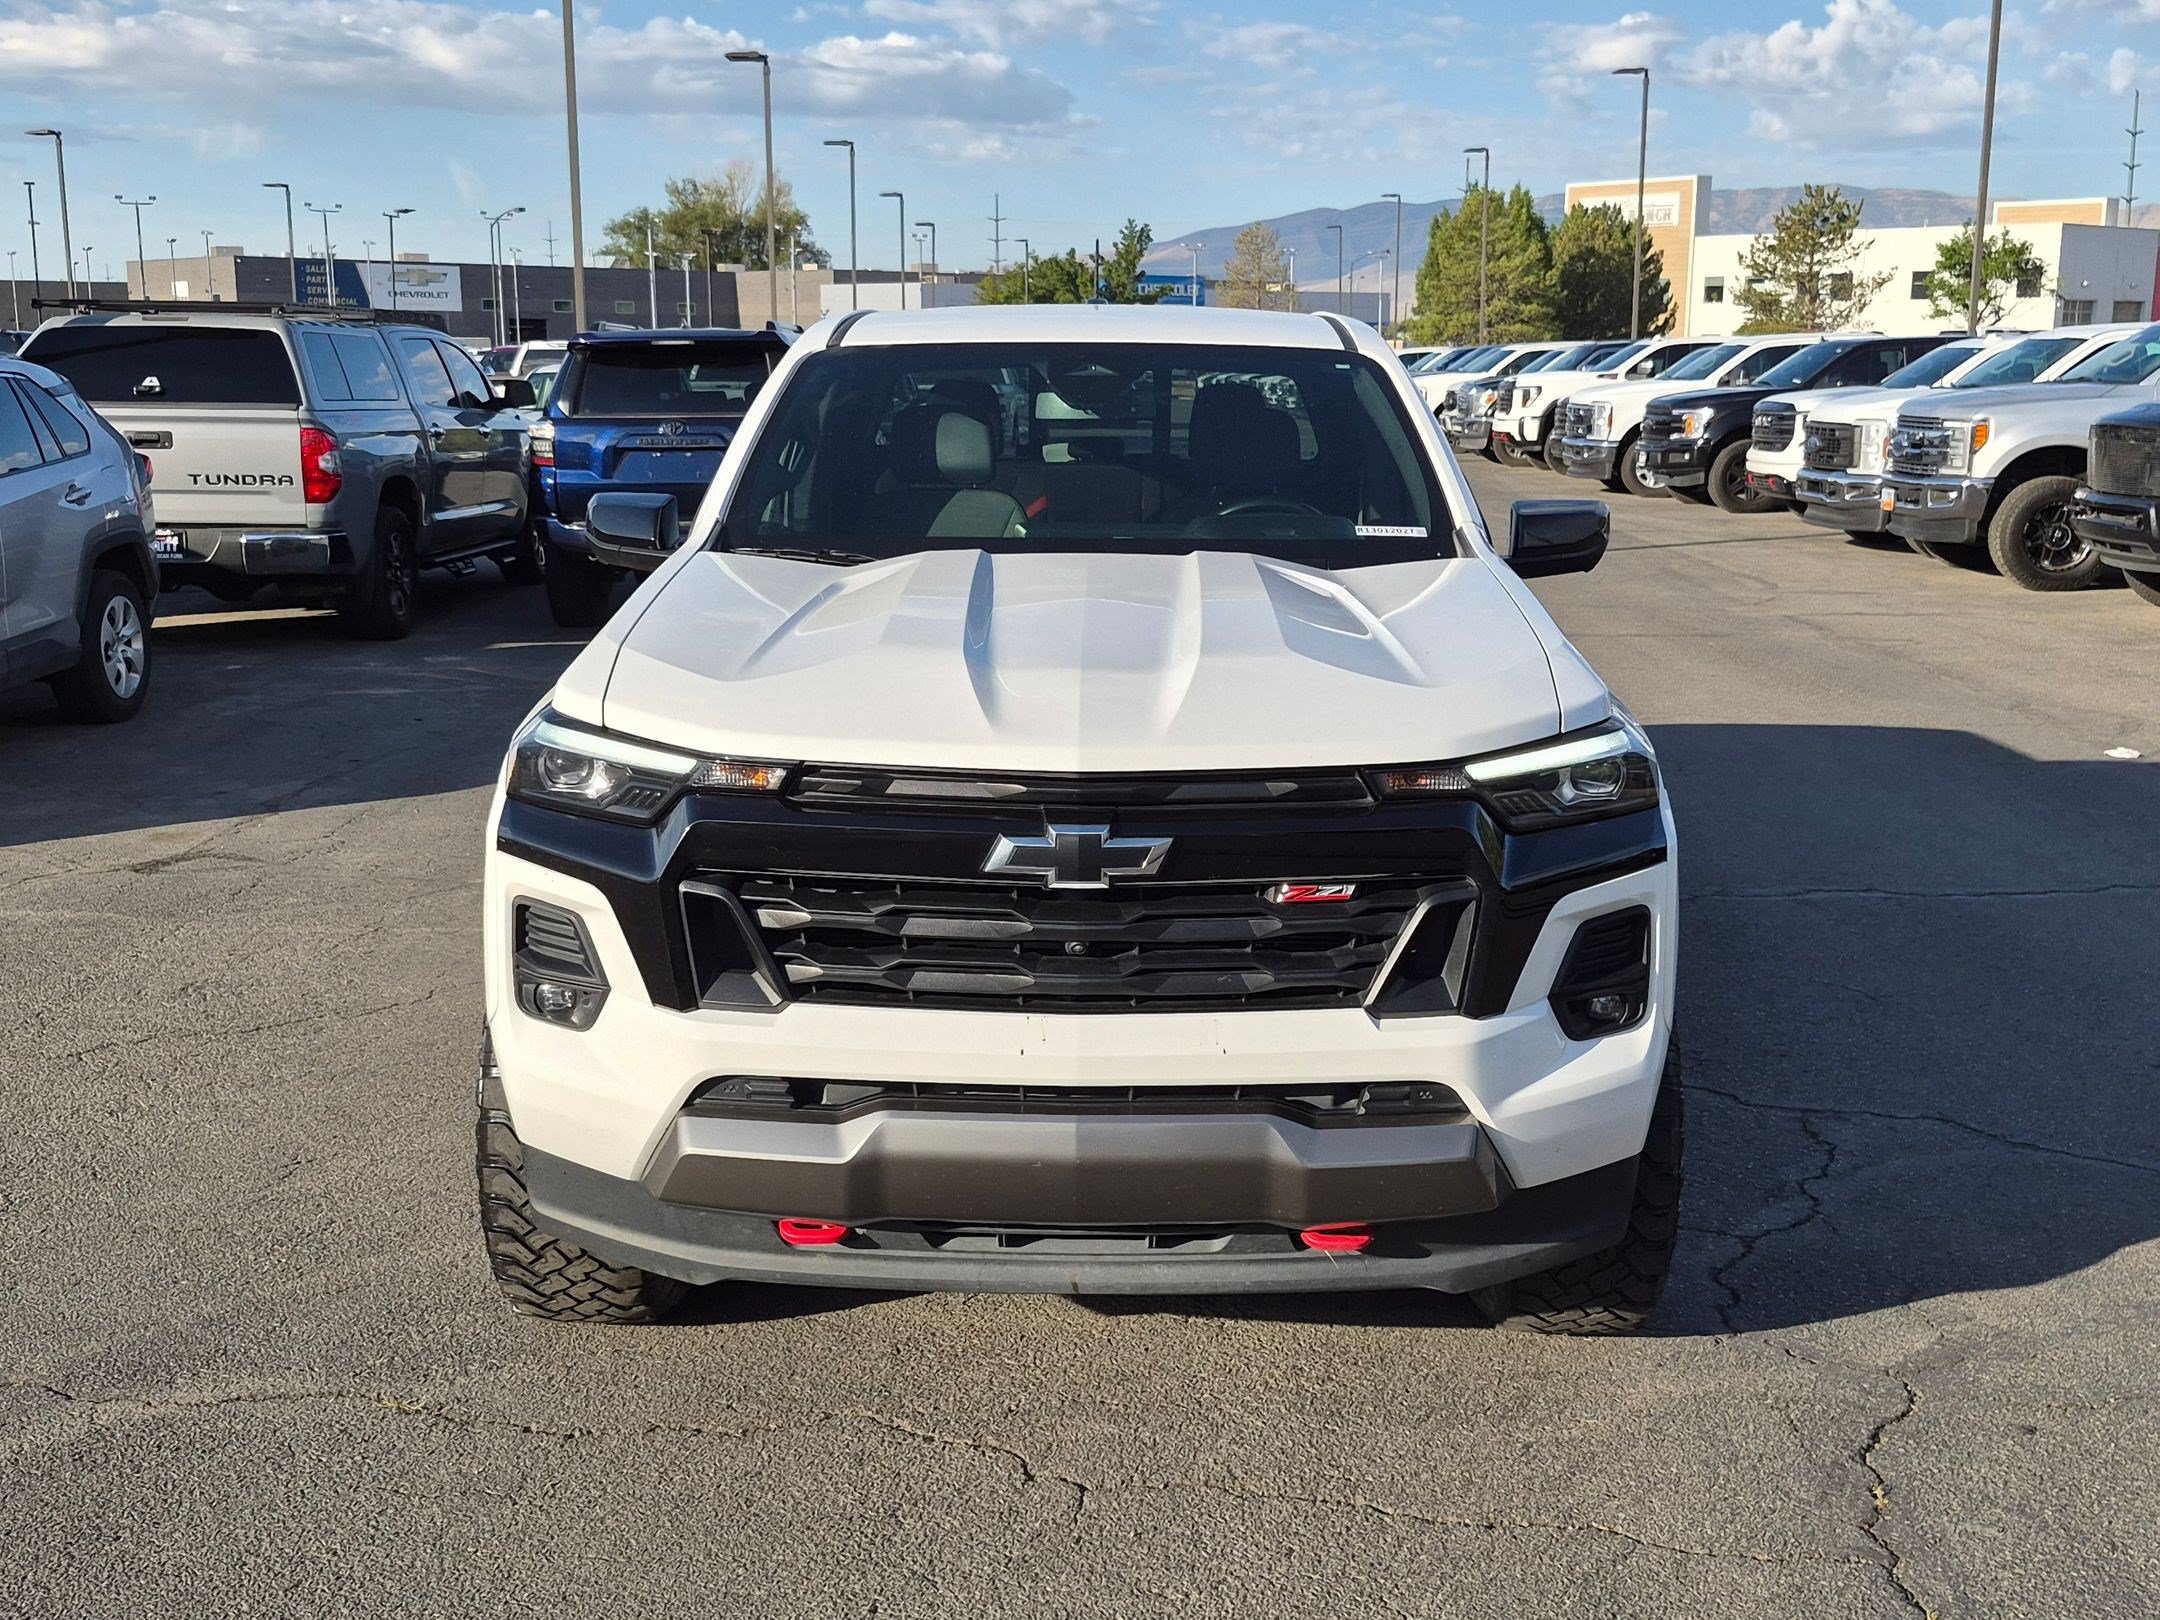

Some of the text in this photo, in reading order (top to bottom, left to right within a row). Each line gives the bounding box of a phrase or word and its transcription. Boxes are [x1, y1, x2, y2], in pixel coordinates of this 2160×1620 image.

[1628, 207, 1672, 223] RNCH
[305, 264, 329, 273] SALE
[306, 275, 329, 284] PART
[388, 291, 449, 299] CHEVROLET
[187, 473, 294, 487] TUNDRA
